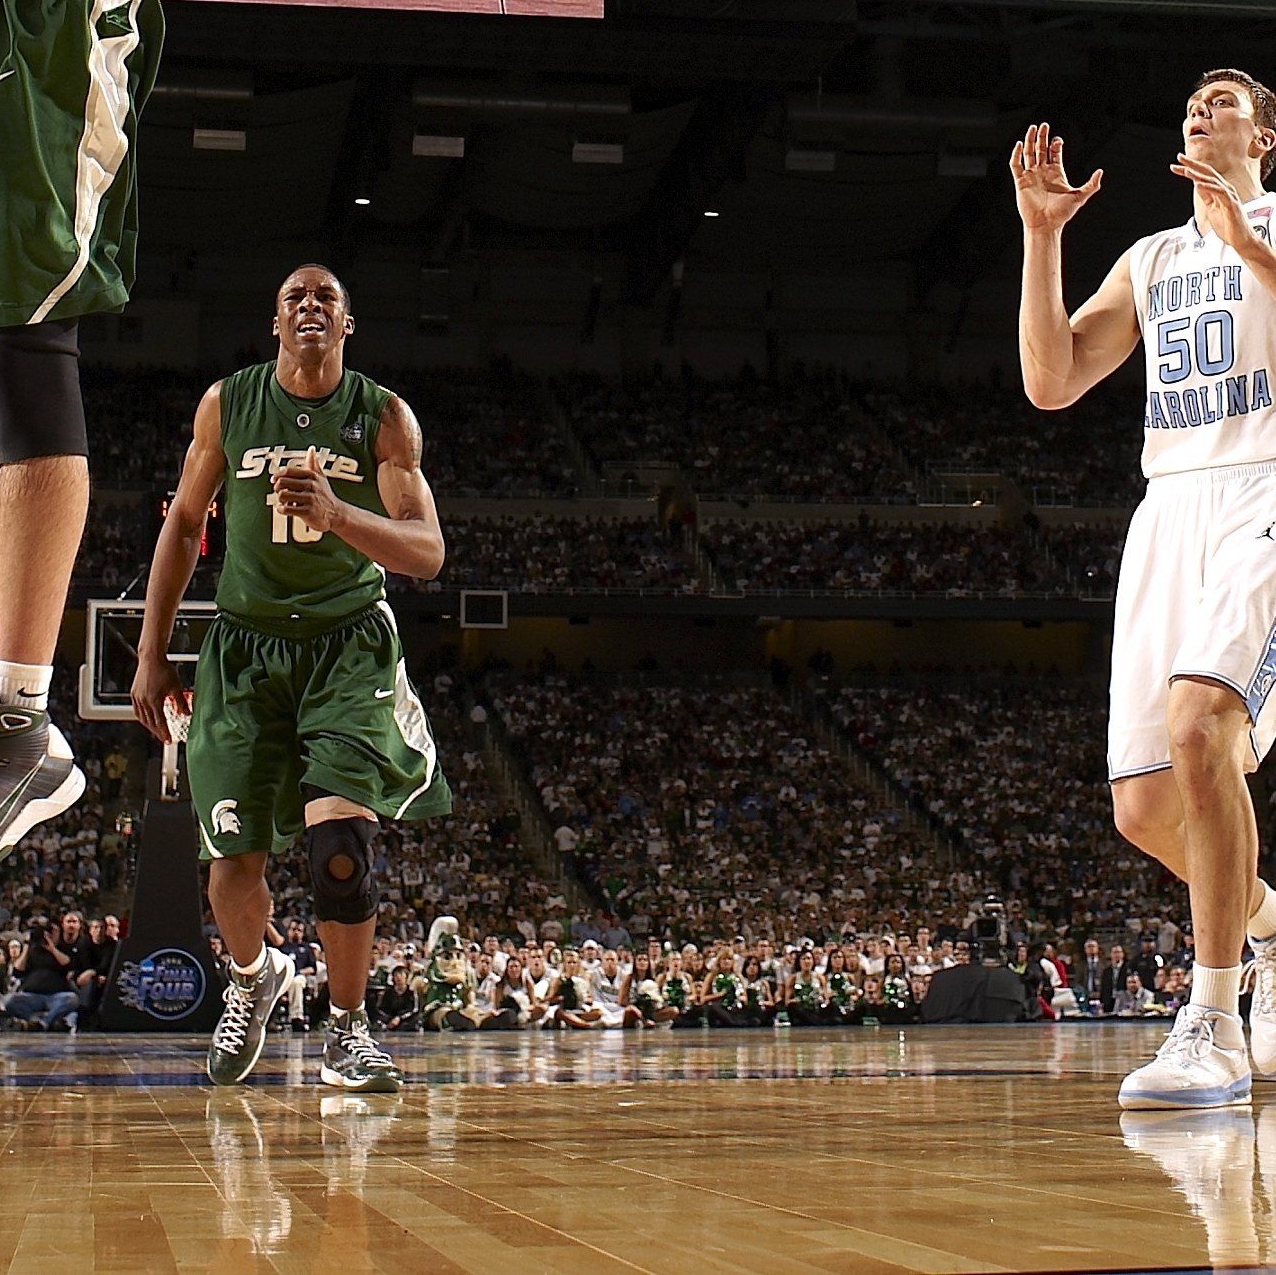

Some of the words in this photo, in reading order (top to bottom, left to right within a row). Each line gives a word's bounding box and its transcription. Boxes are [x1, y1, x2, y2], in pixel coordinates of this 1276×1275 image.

[1148, 265, 1243, 322] NORTH
[1157, 309, 1235, 384] 50
[1144, 368, 1272, 429] AROLINA
[235, 444, 365, 484] State
[136, 976, 196, 1002] FOUR
[155, 964, 195, 983] FINAL
